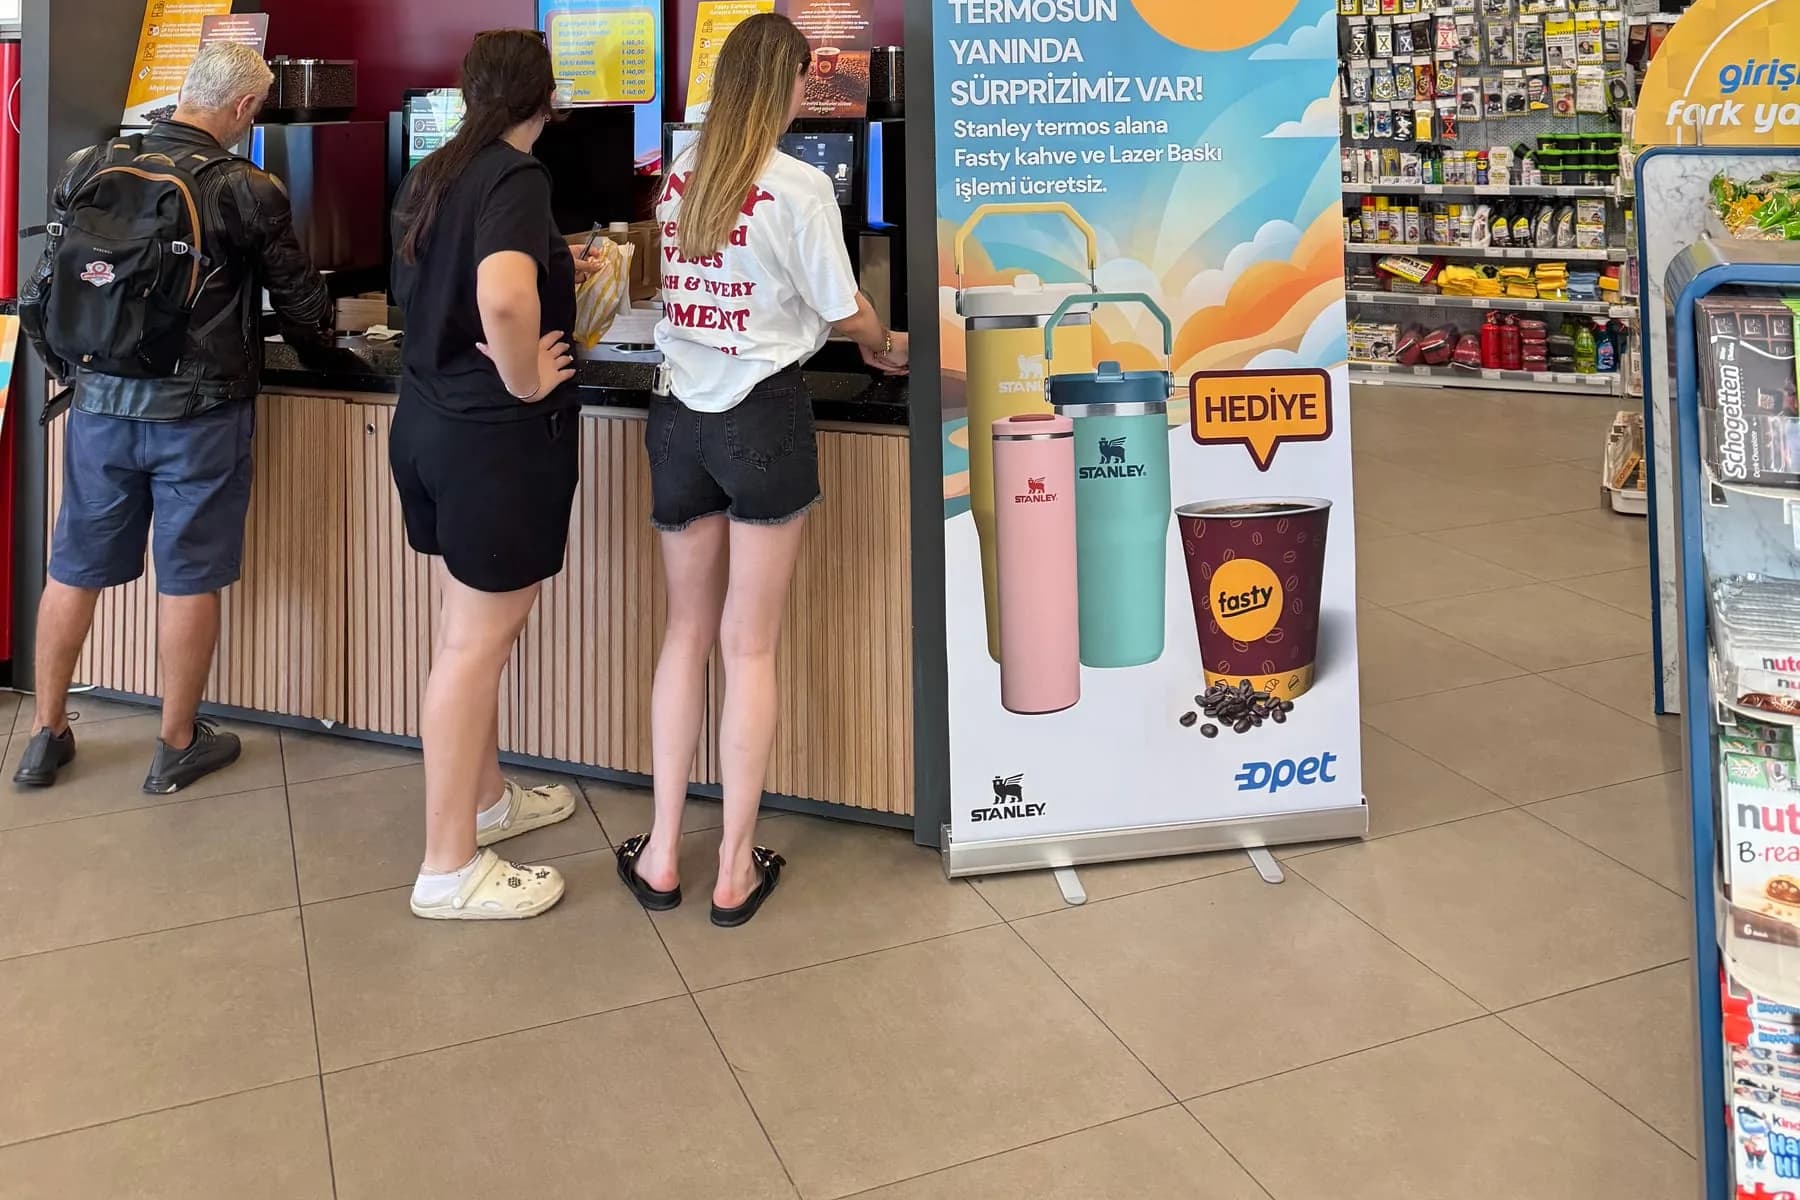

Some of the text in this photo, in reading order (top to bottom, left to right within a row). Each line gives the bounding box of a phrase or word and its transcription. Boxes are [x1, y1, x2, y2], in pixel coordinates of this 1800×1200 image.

[949, 37, 1084, 64] YANINDA
[951, 71, 1204, 105] SÜRPRİZİMİZ VAR!
[1719, 58, 1800, 94] giriş
[1665, 100, 1744, 126] fark
[954, 115, 1168, 141] Stanley termos alana
[954, 142, 1222, 170] Fasty kahve ve Lazer Baskı
[955, 175, 1107, 202] işlemi ücretsiz.
[684, 276, 701, 291] &
[704, 280, 757, 297] EVERY
[666, 303, 750, 332] OMENT
[998, 380, 1044, 393] STANL
[1205, 387, 1318, 423] HEDİYE
[1719, 365, 1748, 480] Schogetten
[1079, 464, 1145, 480] STANLEY
[1014, 493, 1057, 503] STANLEY
[1218, 585, 1274, 614] fasty
[1234, 752, 1337, 793] opet
[971, 802, 1046, 822] STANLEY
